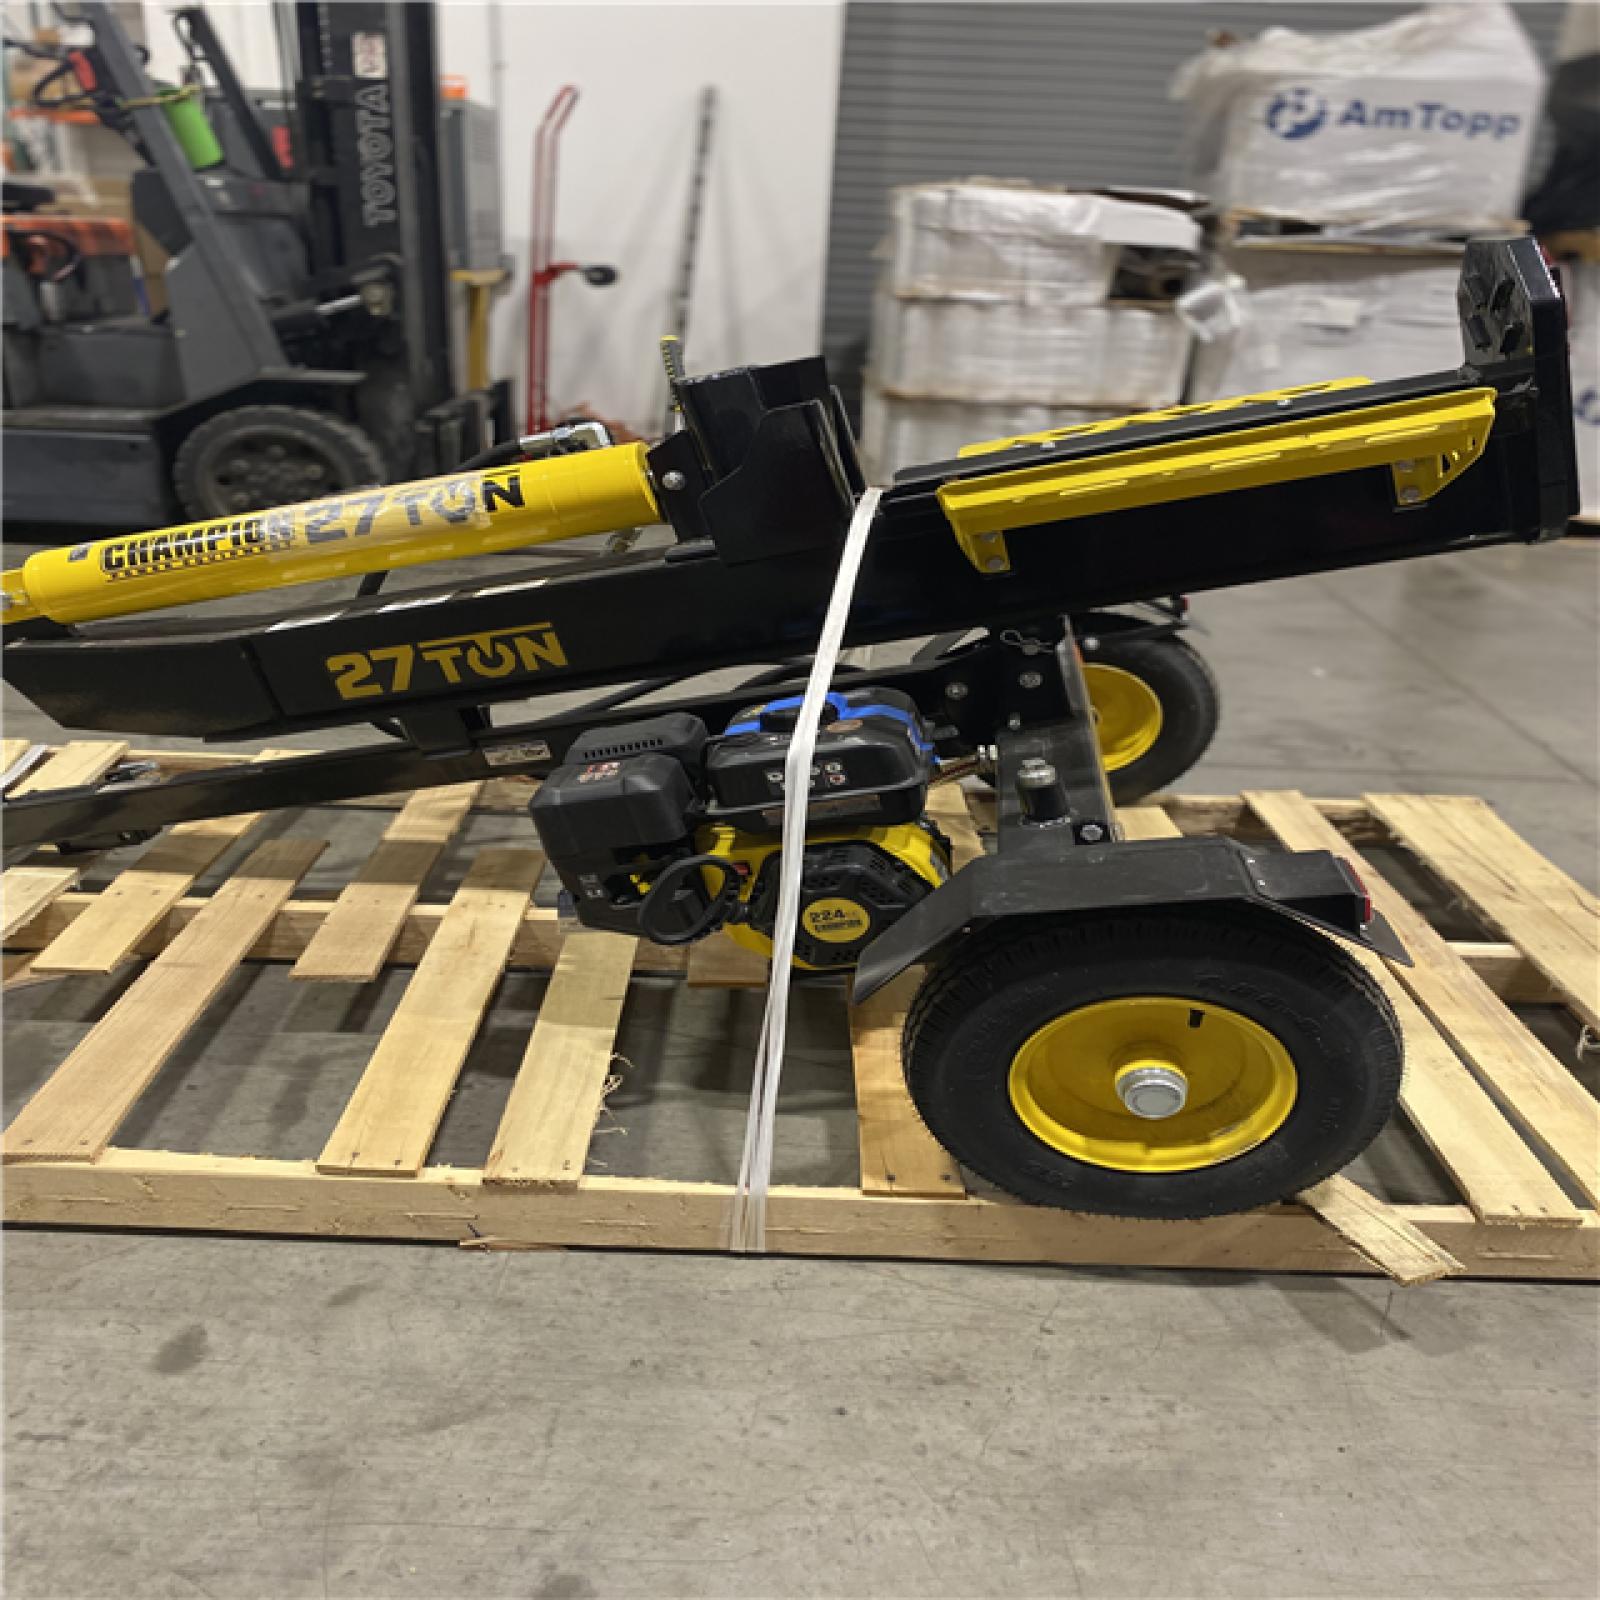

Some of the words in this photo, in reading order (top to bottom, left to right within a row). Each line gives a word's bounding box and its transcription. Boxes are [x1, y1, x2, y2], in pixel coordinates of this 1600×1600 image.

[354, 84, 398, 228] TOYOTA
[1339, 99, 1521, 140] AmTopp
[103, 511, 293, 571] CHAMPION
[304, 494, 386, 544] 27
[325, 644, 414, 700] 27
[417, 621, 568, 684] TON
